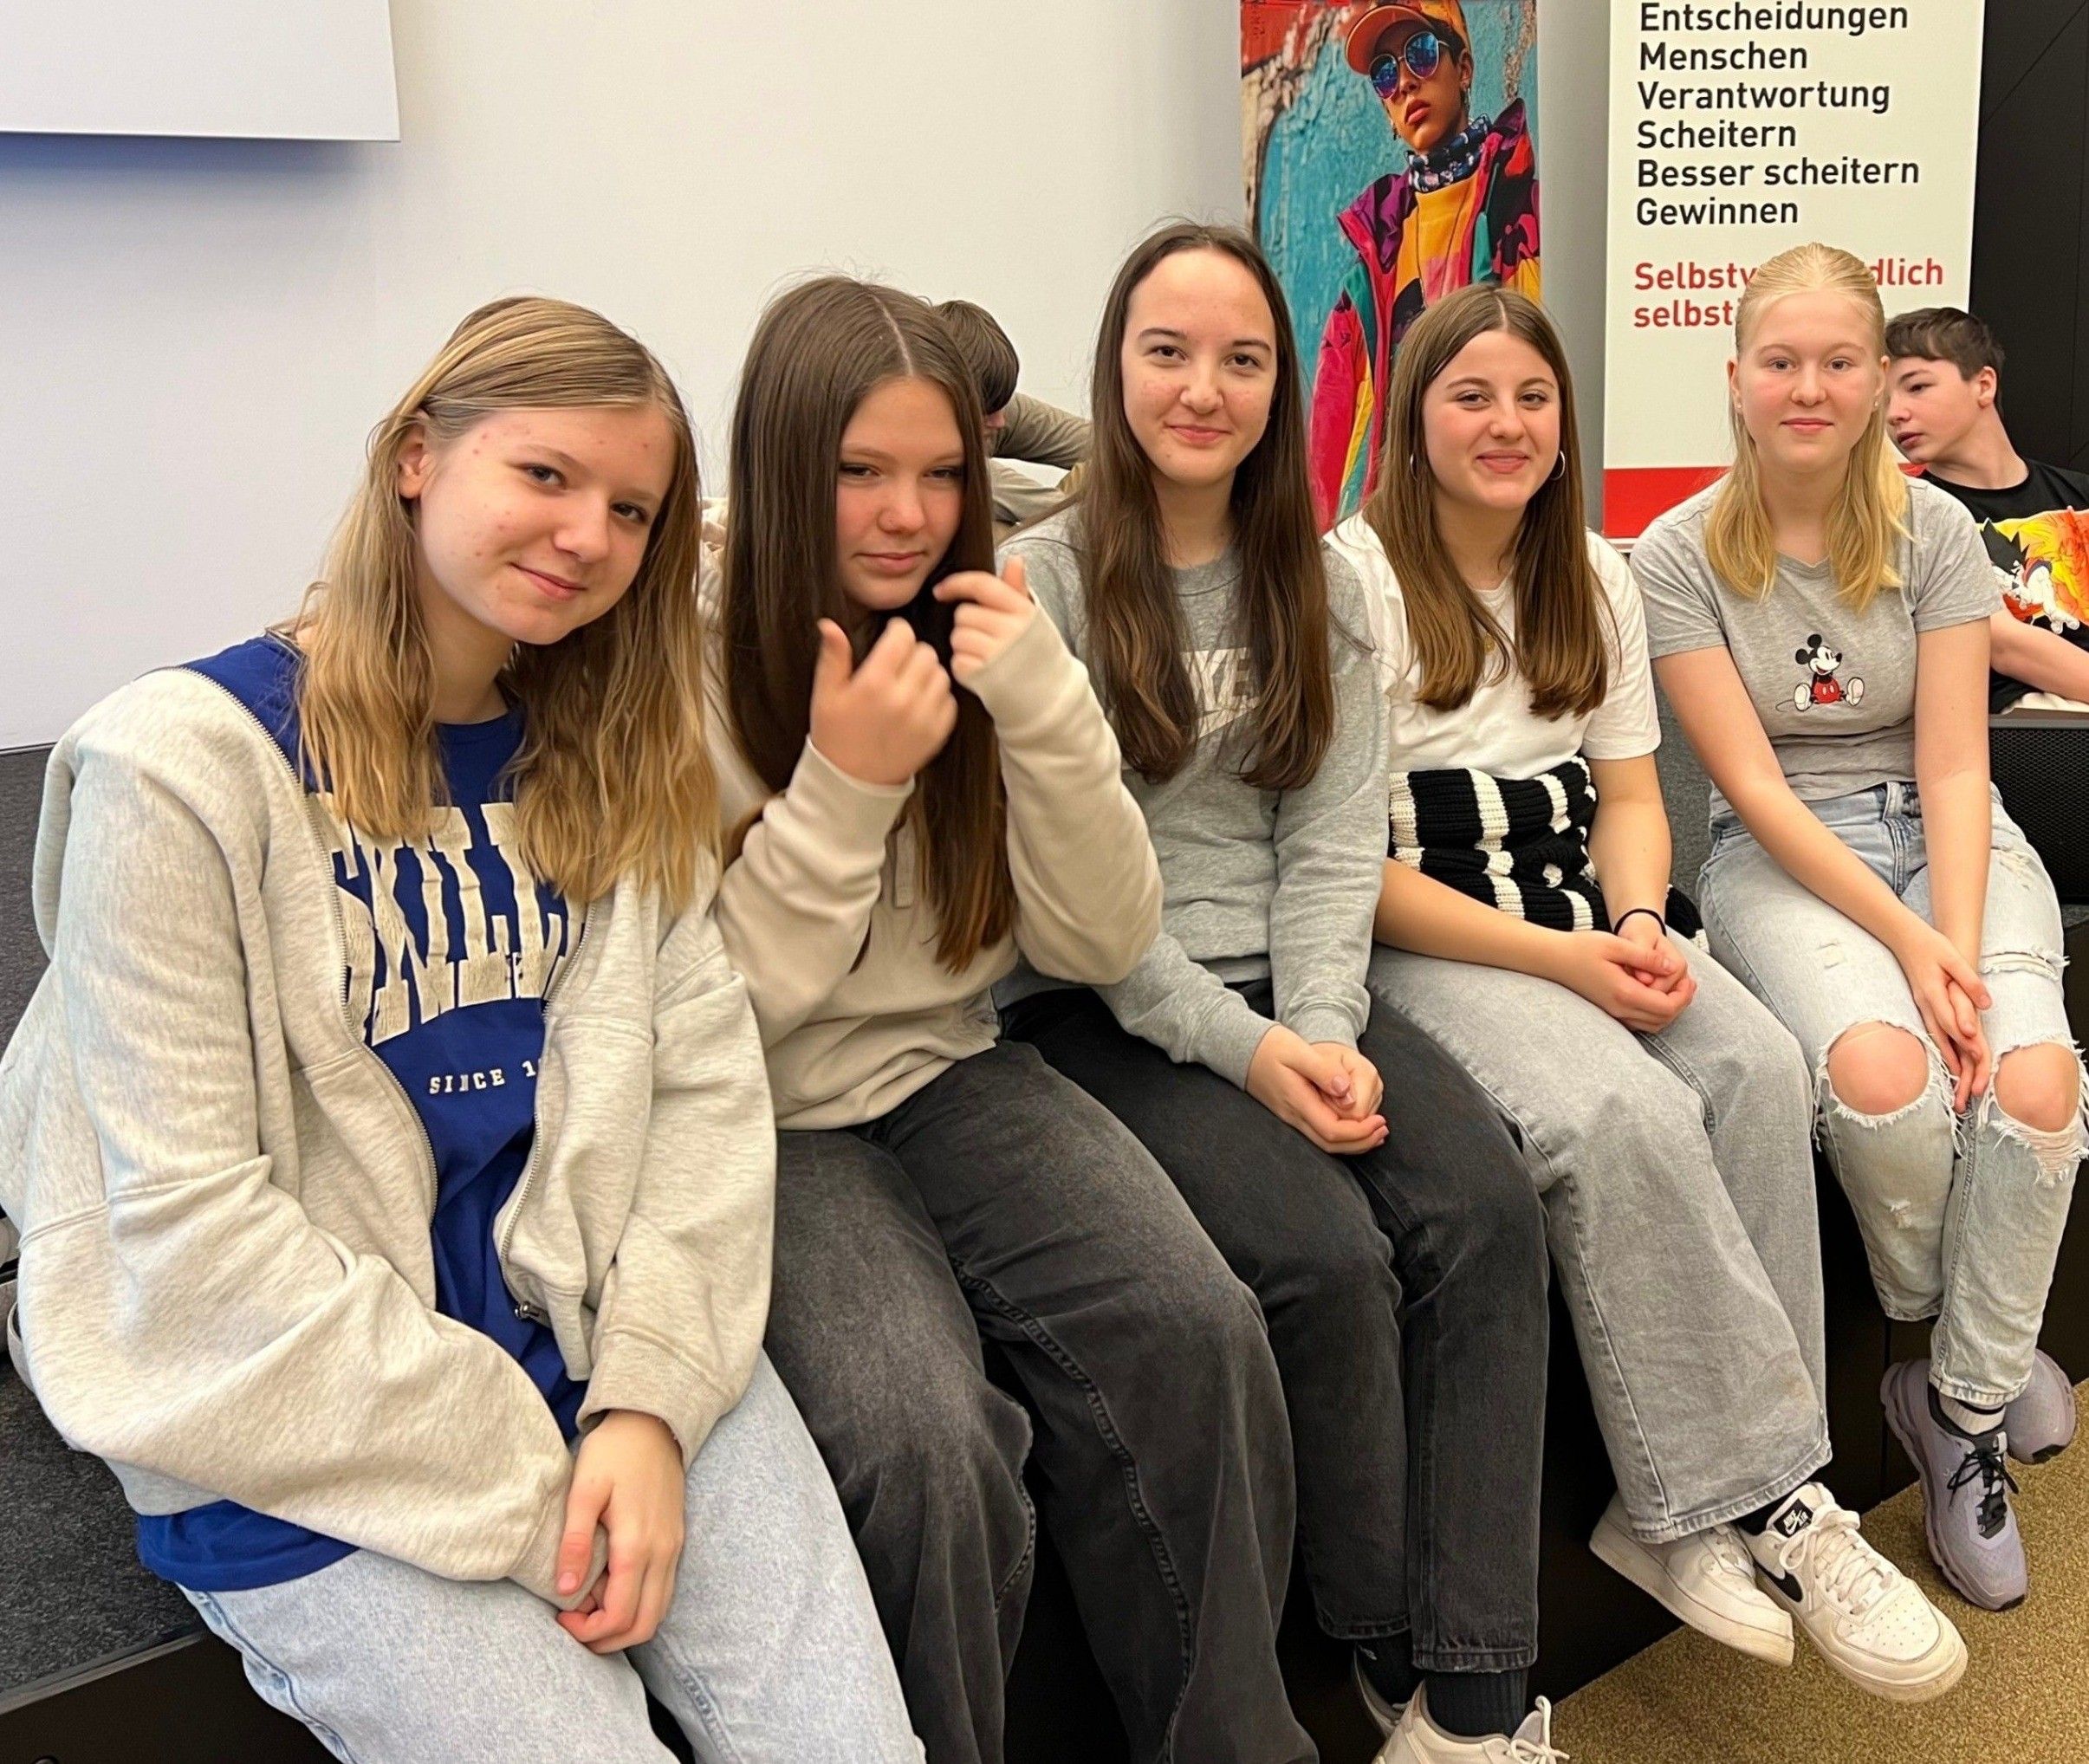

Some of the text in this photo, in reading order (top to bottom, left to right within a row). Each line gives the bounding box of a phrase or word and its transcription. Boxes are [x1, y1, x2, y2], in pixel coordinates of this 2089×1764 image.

[1640, 1, 1908, 36] Entscheidungen
[1639, 42, 1807, 70] Menschen
[1638, 81, 1890, 114] Verantwortung
[1637, 120, 1796, 149] Scheitern
[1638, 157, 1919, 187] Besser scheitern
[1637, 197, 1798, 225] Gewinnen
[1634, 258, 1943, 290] Selbstvdlich
[1634, 300, 1742, 328] selbst
